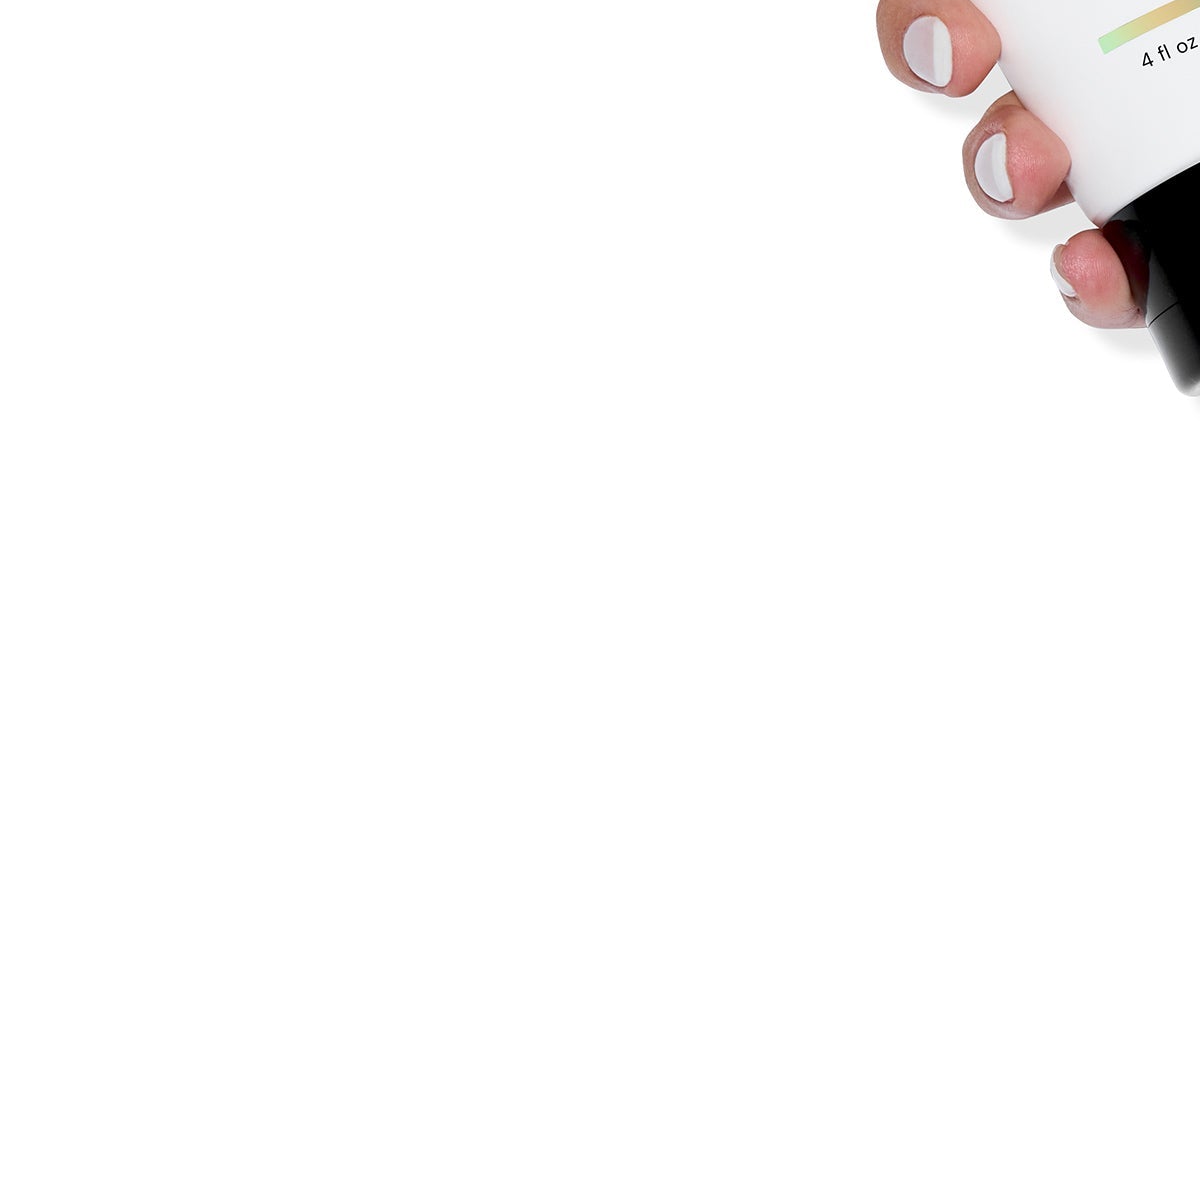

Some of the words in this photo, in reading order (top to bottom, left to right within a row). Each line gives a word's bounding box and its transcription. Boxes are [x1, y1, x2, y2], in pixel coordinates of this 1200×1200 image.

[1142, 52, 1154, 67] 4
[1157, 44, 1171, 62] fl
[1176, 36, 1199, 54] oz
